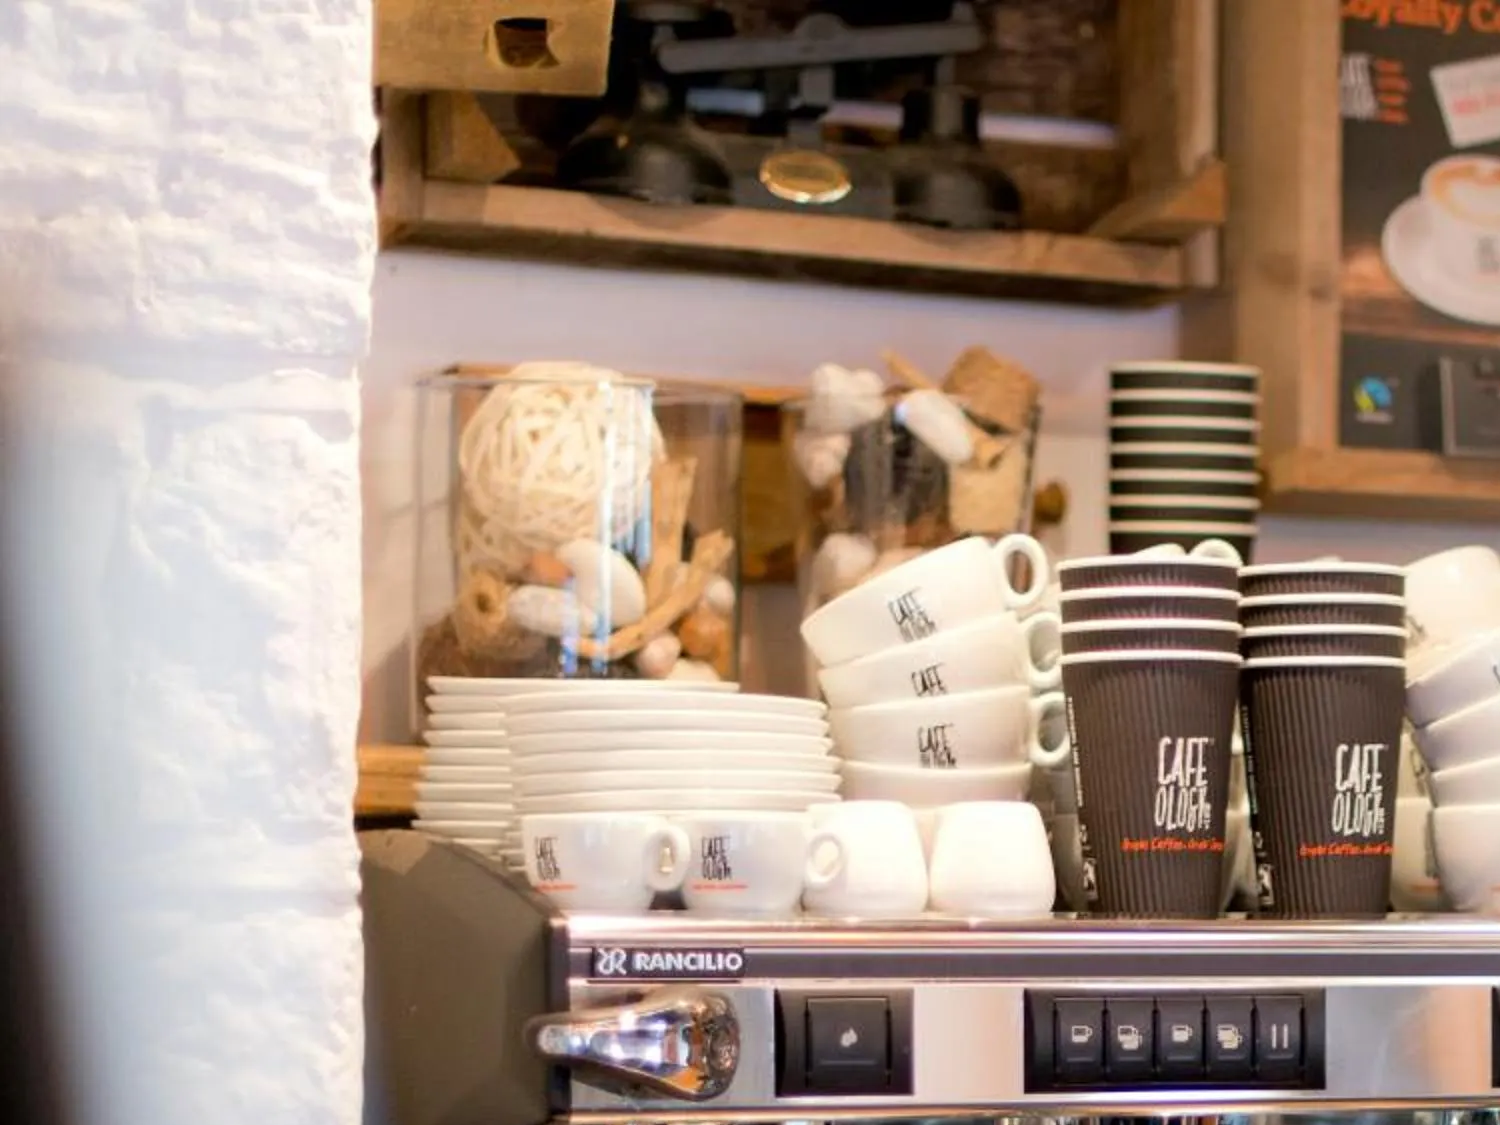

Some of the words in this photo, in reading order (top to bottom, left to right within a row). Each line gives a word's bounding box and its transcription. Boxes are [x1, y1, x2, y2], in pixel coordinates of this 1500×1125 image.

[1343, 0, 1462, 34] oyalty
[1158, 736, 1210, 787] CAFE
[1335, 743, 1385, 793] CAFE
[633, 952, 743, 972] RANCILIO
